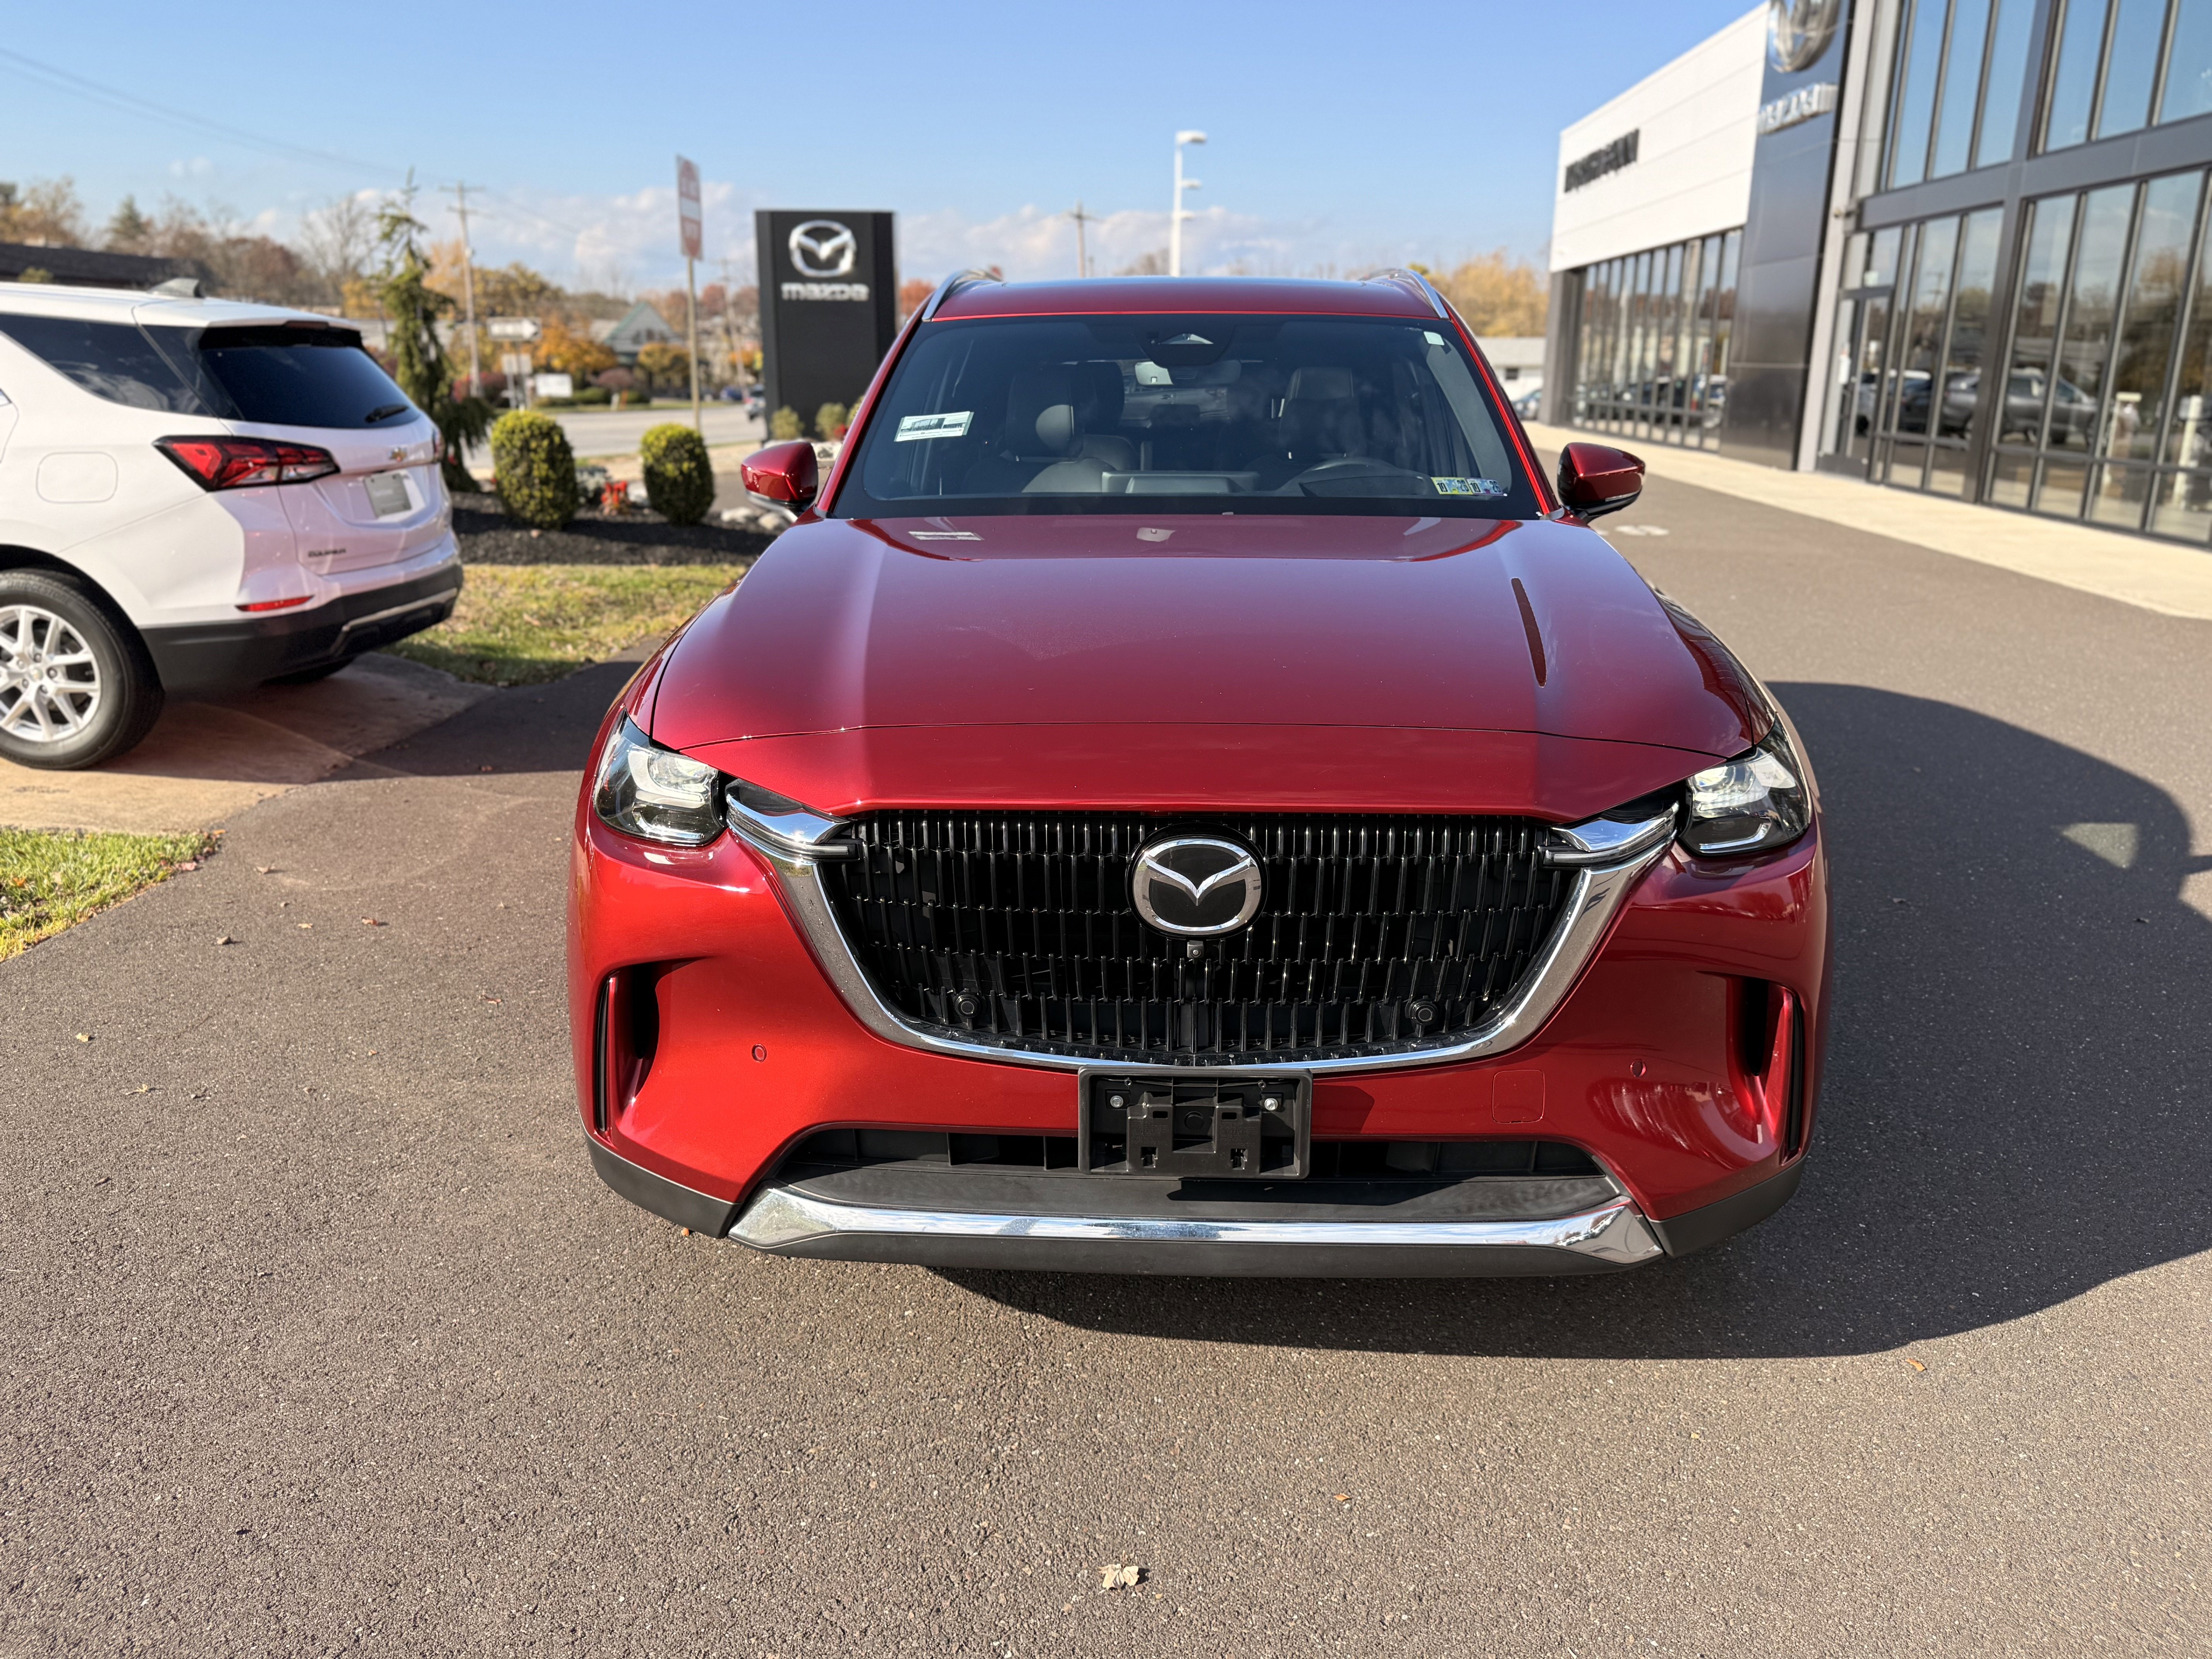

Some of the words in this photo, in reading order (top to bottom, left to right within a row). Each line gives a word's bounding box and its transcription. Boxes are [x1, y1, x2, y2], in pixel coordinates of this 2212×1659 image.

[781, 282, 870, 301] mazda
[1436, 483, 1448, 492] 10
[1470, 483, 1481, 493] 10
[1489, 481, 1501, 493] 26
